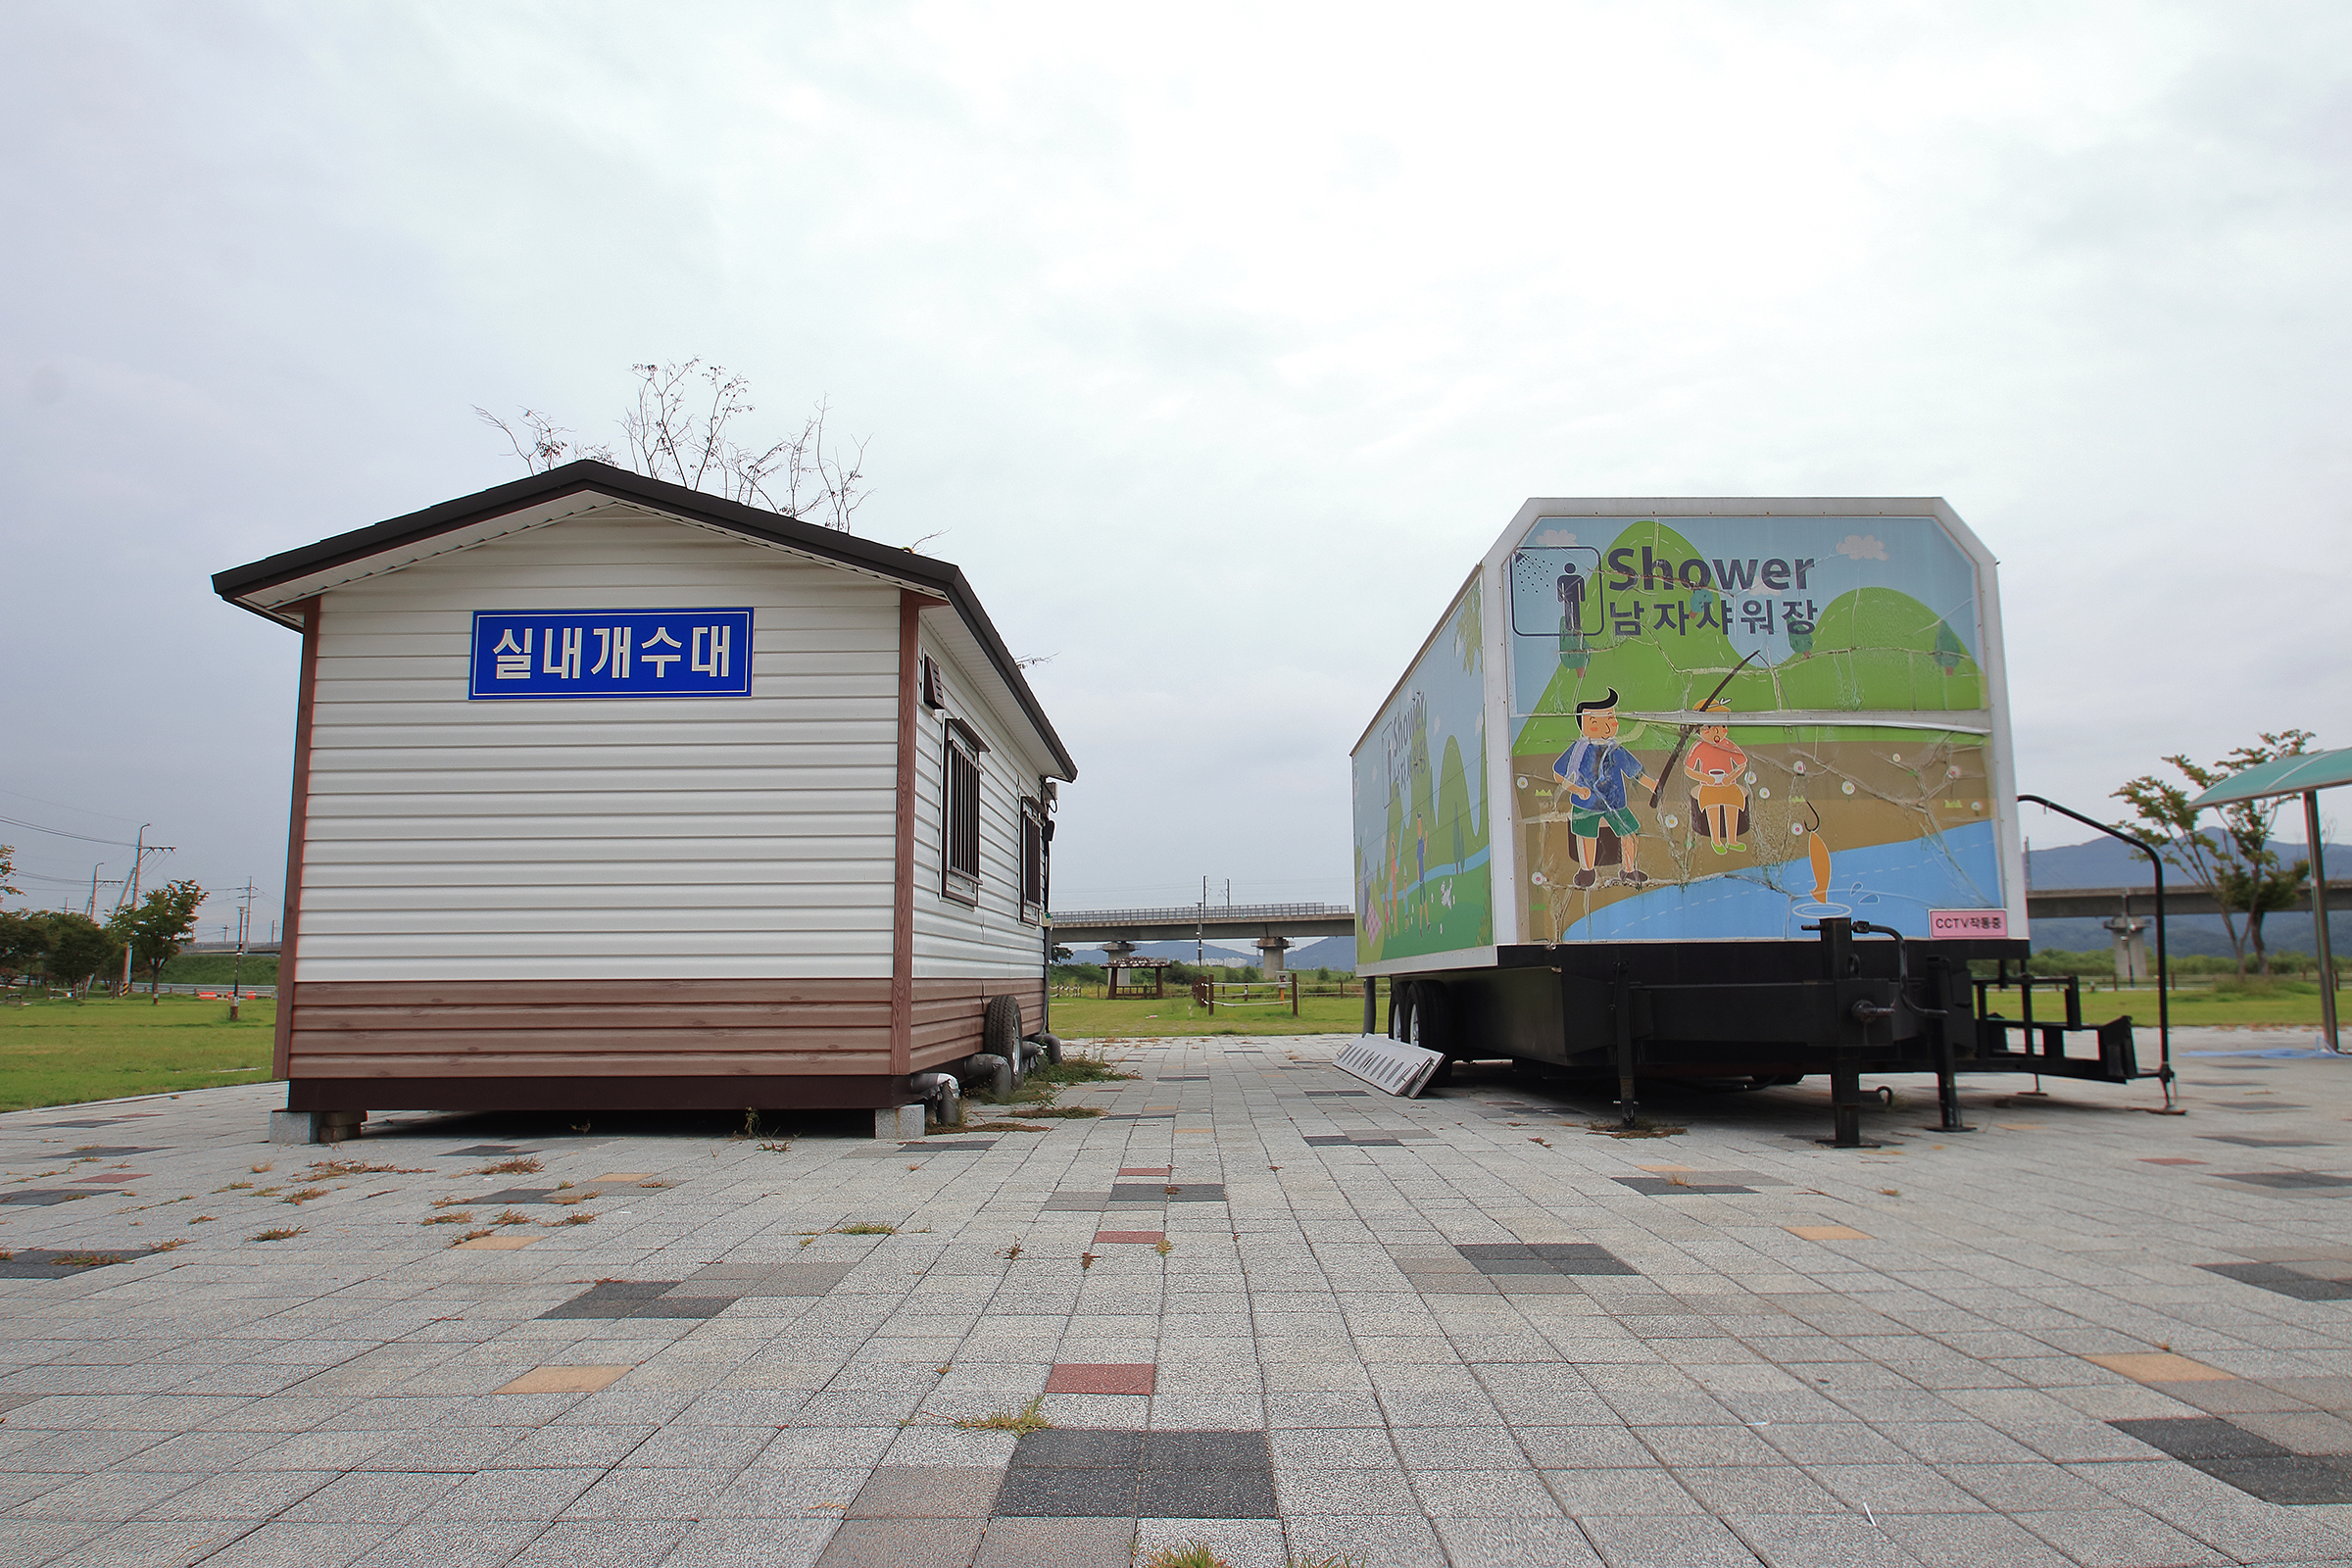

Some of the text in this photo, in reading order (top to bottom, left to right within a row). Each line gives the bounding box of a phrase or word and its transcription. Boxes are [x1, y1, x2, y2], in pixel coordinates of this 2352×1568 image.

[1608, 546, 1815, 591] Shower
[1609, 599, 1818, 636] 남자샤워장
[492, 625, 731, 679] 실내개수대
[1393, 691, 1426, 758] Shower
[1936, 916, 2001, 929] CCTV작동중
